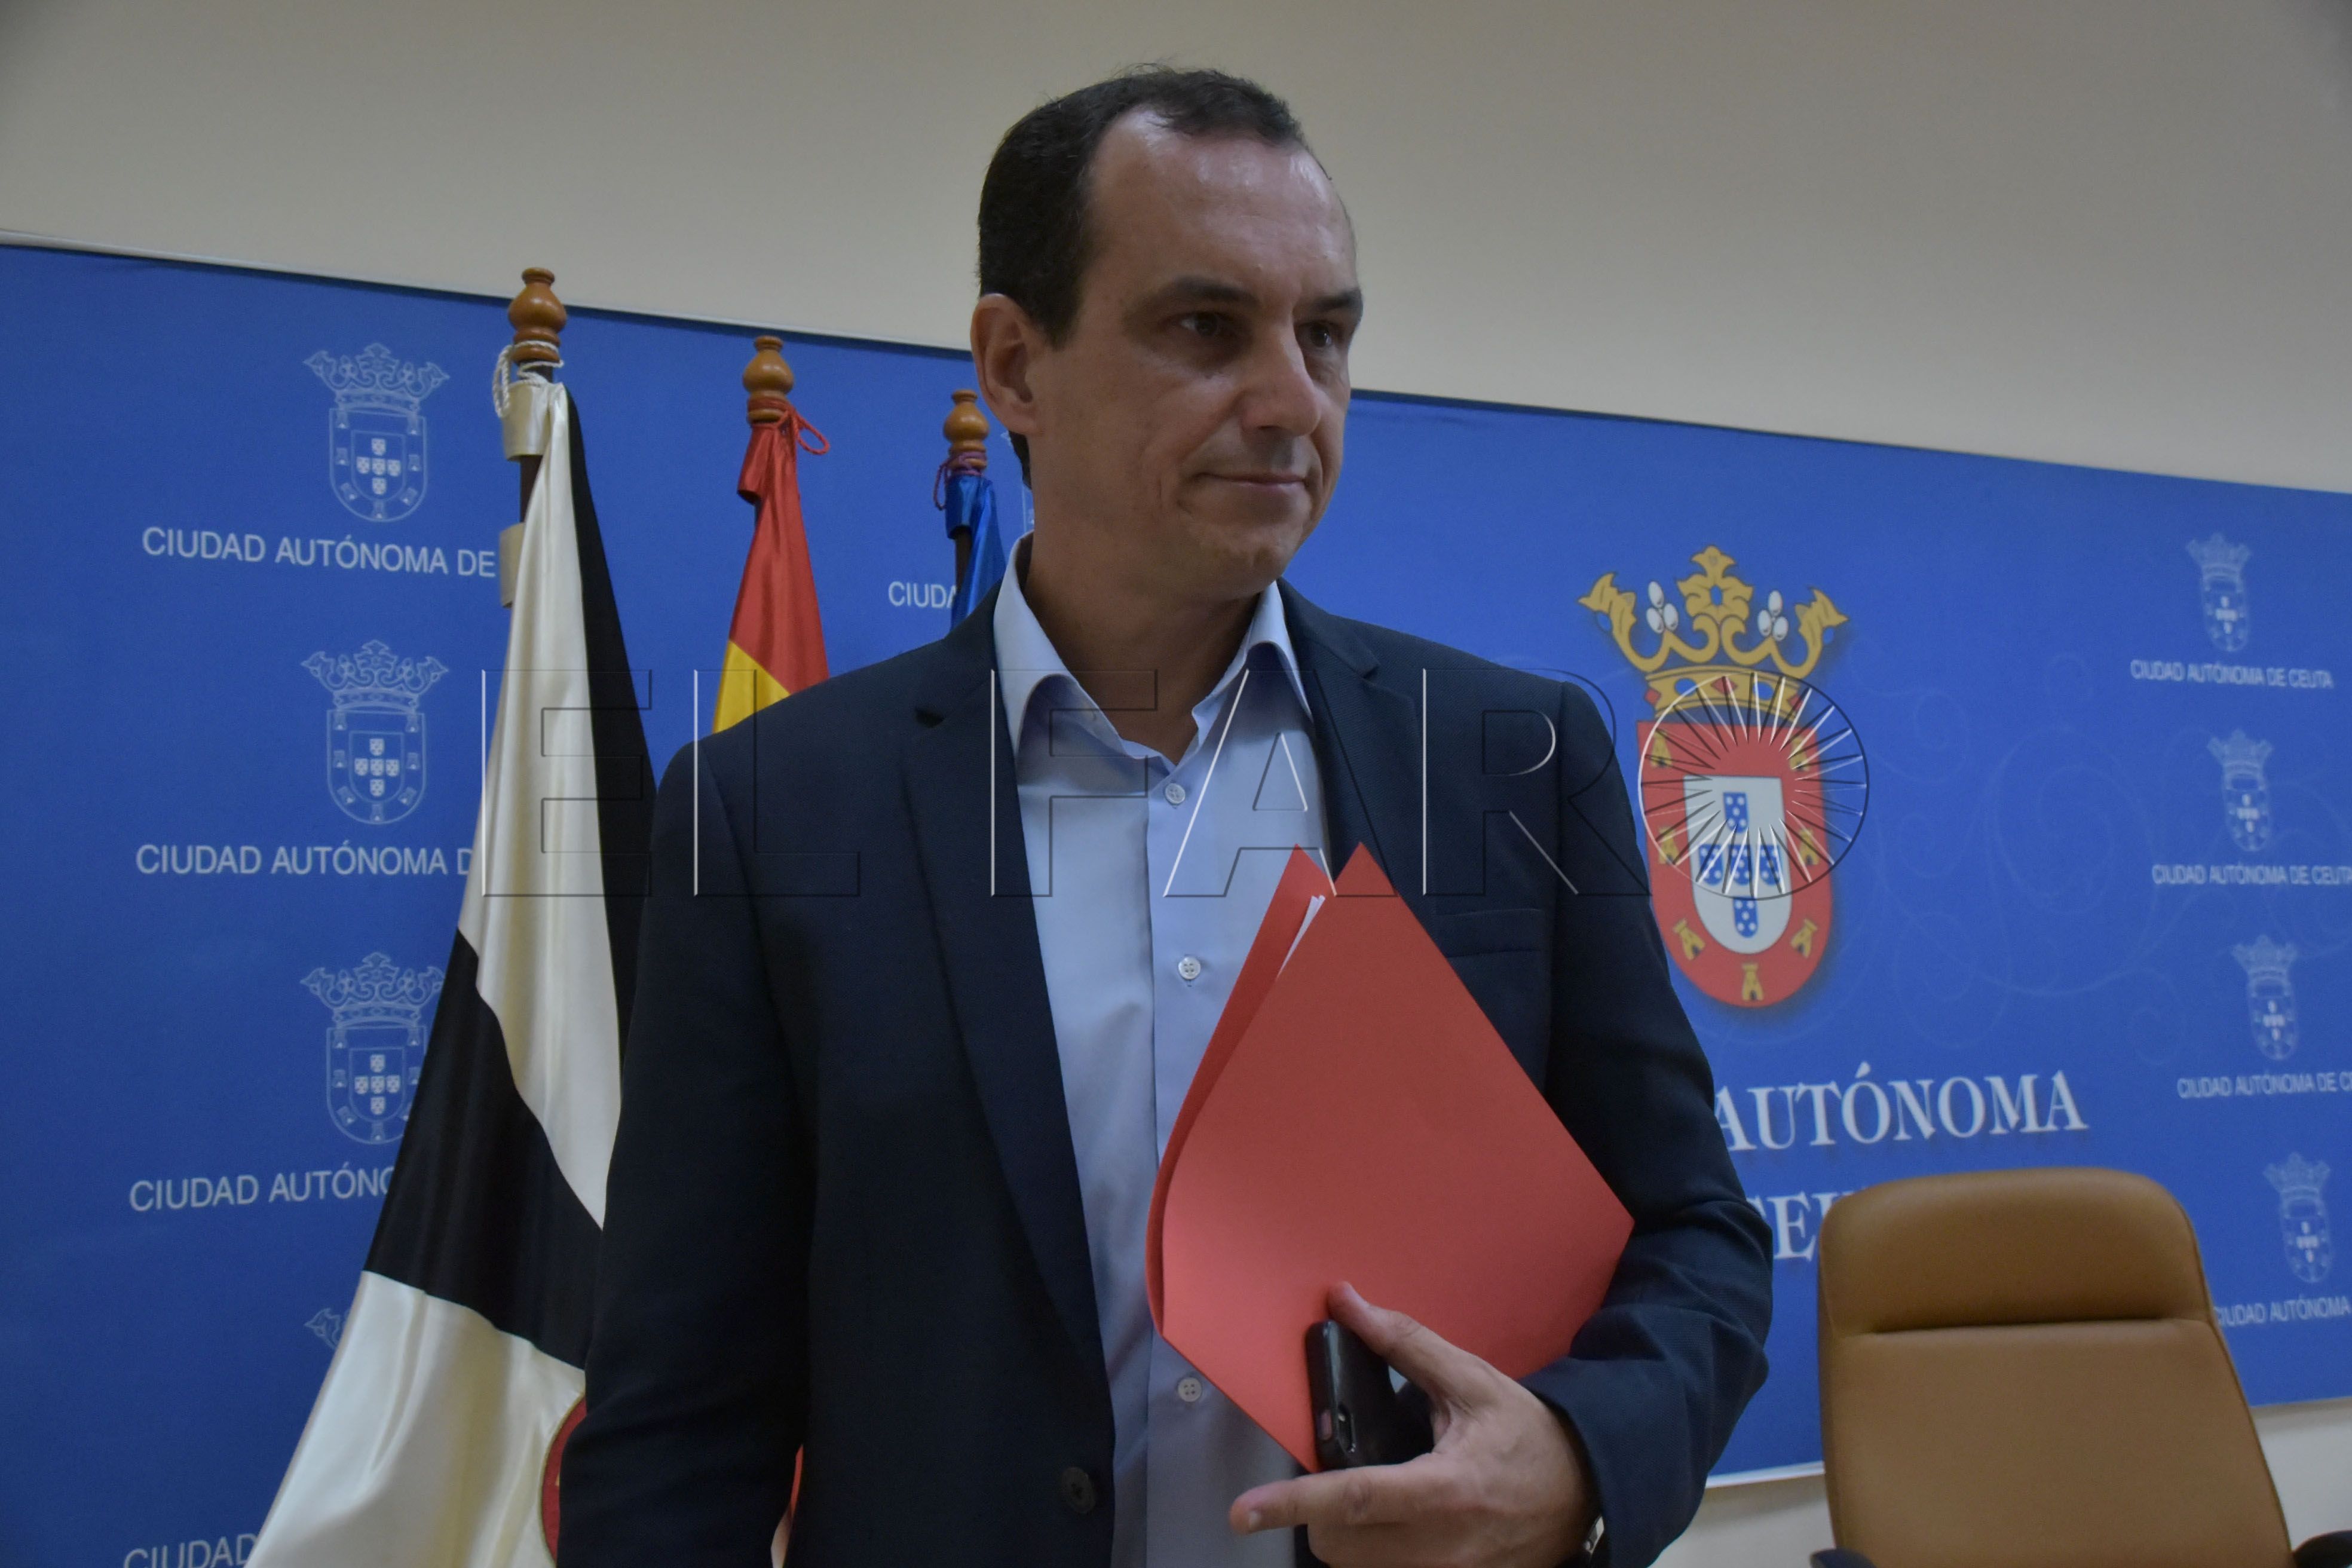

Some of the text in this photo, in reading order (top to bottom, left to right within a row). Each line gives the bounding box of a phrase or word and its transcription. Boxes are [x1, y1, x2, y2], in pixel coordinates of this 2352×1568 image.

[142, 526, 496, 577] CIUDAD AUTÓNOMA DE
[2130, 659, 2334, 688] CIUDAD AUTÓNOMA DE CEUTA
[136, 844, 262, 875] CIUDAD
[270, 840, 448, 875] AUTÓNOMA
[2152, 864, 2207, 885] CIUDAD
[2210, 861, 2287, 885] AUTÓNOMA
[2289, 865, 2310, 885] DE
[2177, 1076, 2232, 1099] CIUDAD
[2235, 1071, 2315, 1096] AUTÓNOMA
[2316, 1072, 2338, 1092] DE
[1713, 1061, 2089, 1152] AUTÓNOMA
[129, 1175, 259, 1212] CIUDAD
[2270, 1295, 2351, 1322] AUTÓNOMA
[123, 1533, 258, 1568] CIUDAD
